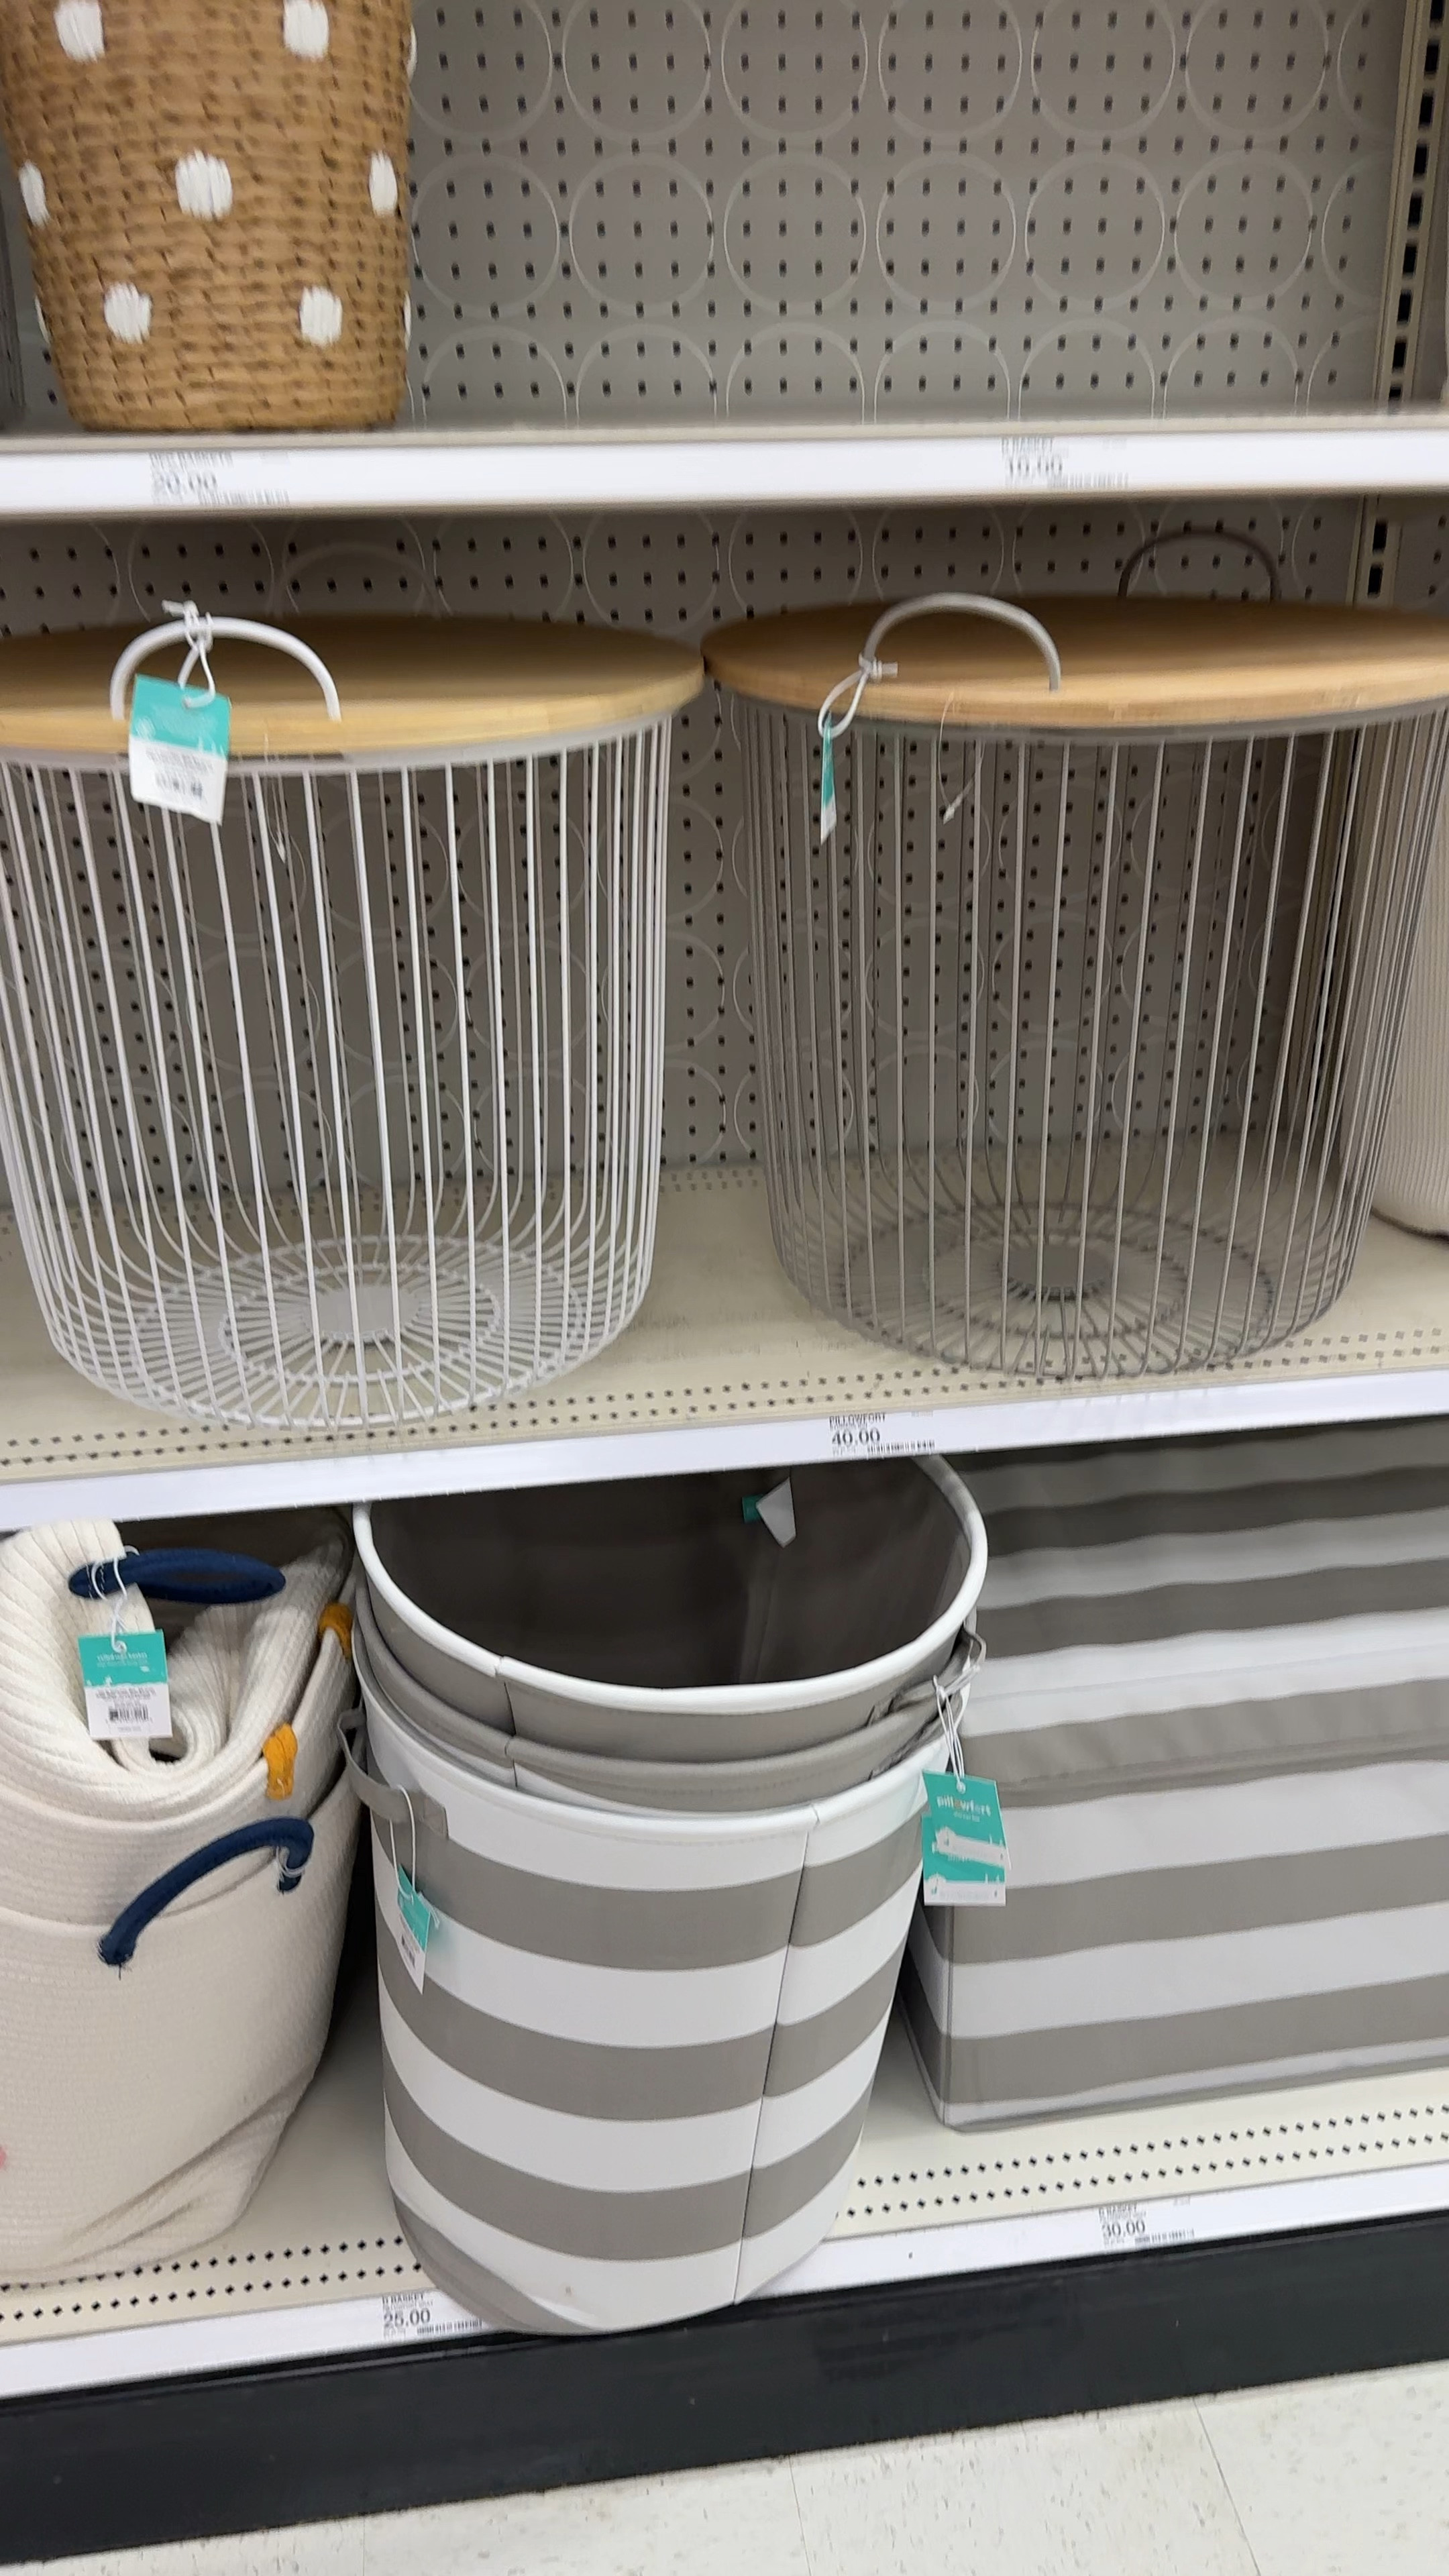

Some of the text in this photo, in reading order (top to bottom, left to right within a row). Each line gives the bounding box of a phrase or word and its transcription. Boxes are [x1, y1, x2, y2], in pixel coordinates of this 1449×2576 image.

[830, 1411, 886, 1428] PILLOWFORT
[831, 1428, 881, 1447] 40.00
[1102, 2219, 1145, 2238] 30.00
[383, 2308, 431, 2328] 25.00
